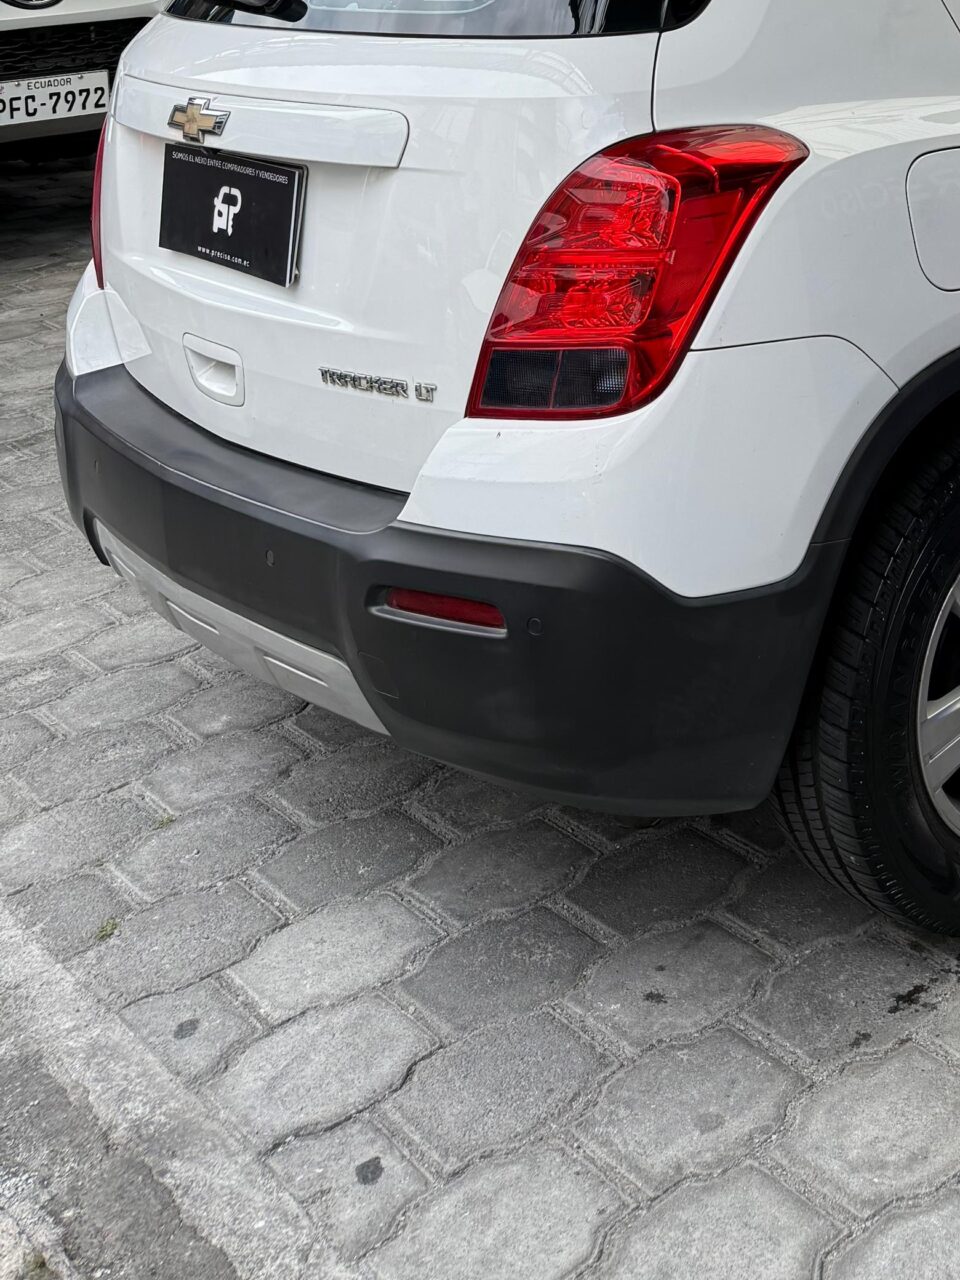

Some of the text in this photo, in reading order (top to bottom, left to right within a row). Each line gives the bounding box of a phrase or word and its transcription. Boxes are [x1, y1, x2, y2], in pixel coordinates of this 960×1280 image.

[27, 77, 72, 90] ECUADOR
[172, 151, 189, 162] SOMOS
[207, 158, 222, 169] ENTRE
[222, 161, 255, 177] COMPRADORES
[259, 170, 289, 185] VENDEDORES
[197, 245, 250, 268] www.preciso.com.ec
[318, 366, 438, 403] TRACKER LT
